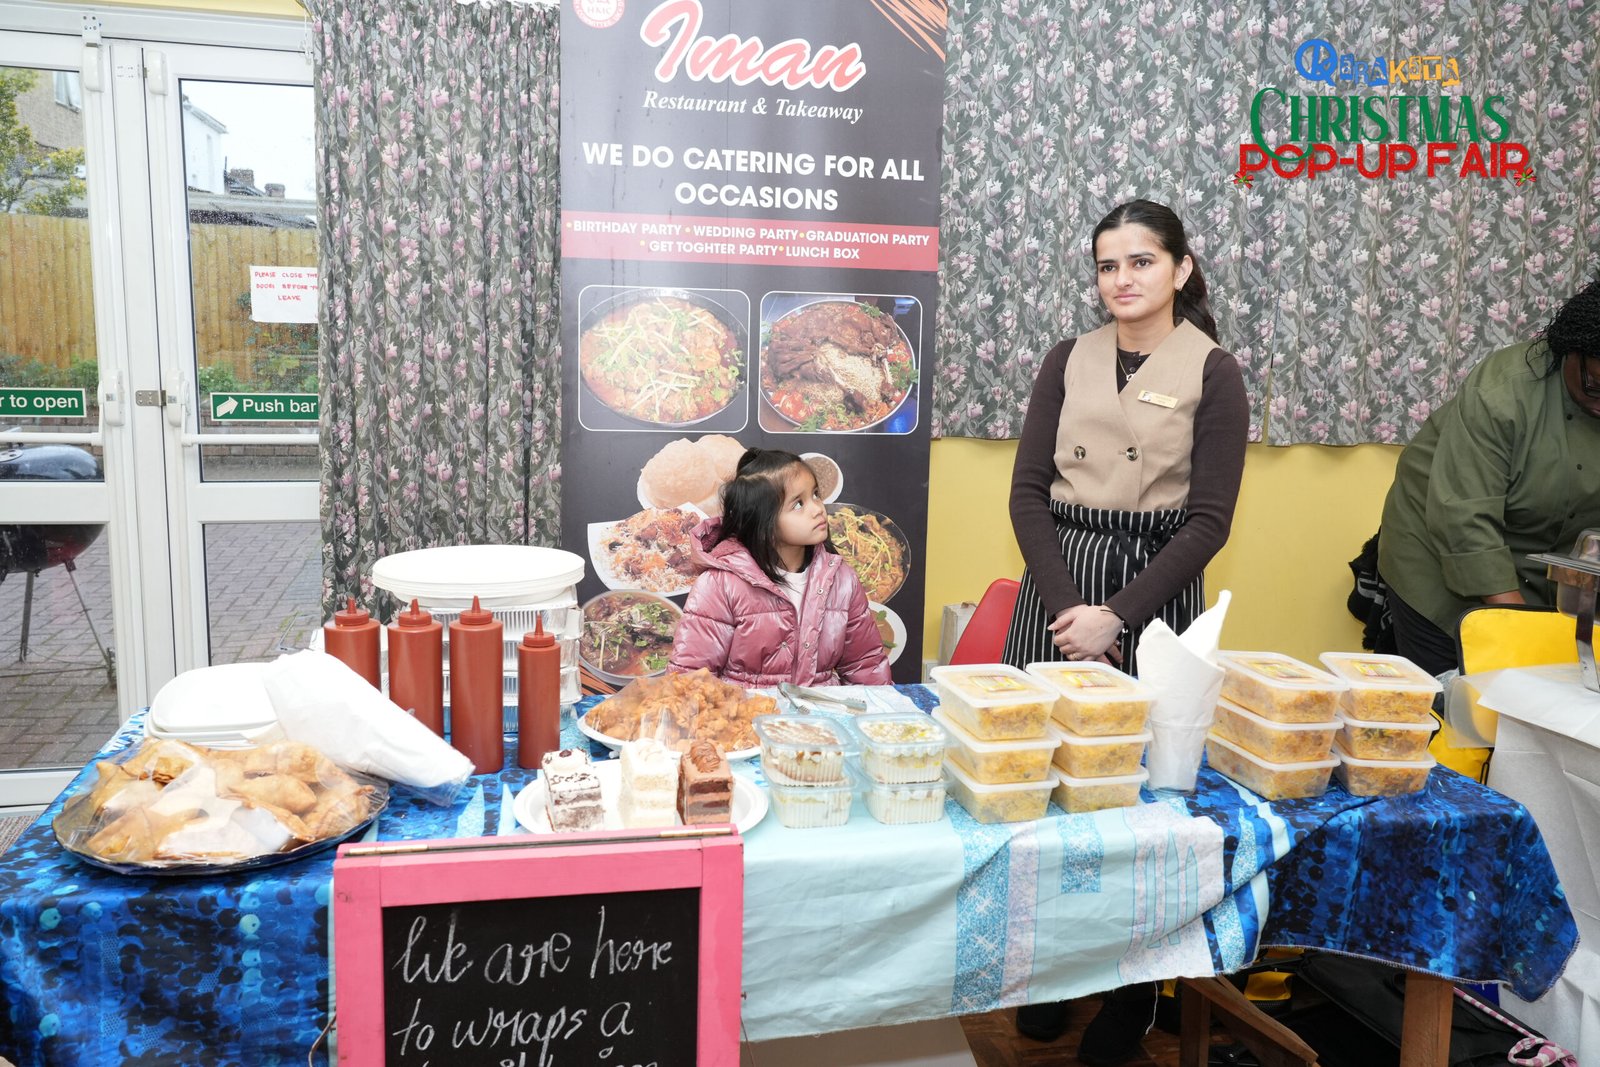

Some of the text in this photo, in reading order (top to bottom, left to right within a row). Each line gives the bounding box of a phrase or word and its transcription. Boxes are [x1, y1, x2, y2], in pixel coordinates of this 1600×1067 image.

[640, 0, 867, 92] Iman
[642, 90, 863, 124] Restaurant & Takeaway
[582, 142, 925, 181] WE DO CATERING FOR ALL
[675, 182, 838, 211] OCCASIONS
[573, 220, 930, 246] BIRTHDAY PARTY WEDDING PARTY GRADUATION PARTY
[649, 240, 860, 260] GET TOGHTER PARTY LUNCH BOX
[9, 394, 28, 408] to
[33, 396, 79, 412] open
[242, 398, 317, 413] Push bar
[484, 932, 571, 985] are
[590, 905, 672, 979] here
[392, 998, 634, 1067] to wraps a
